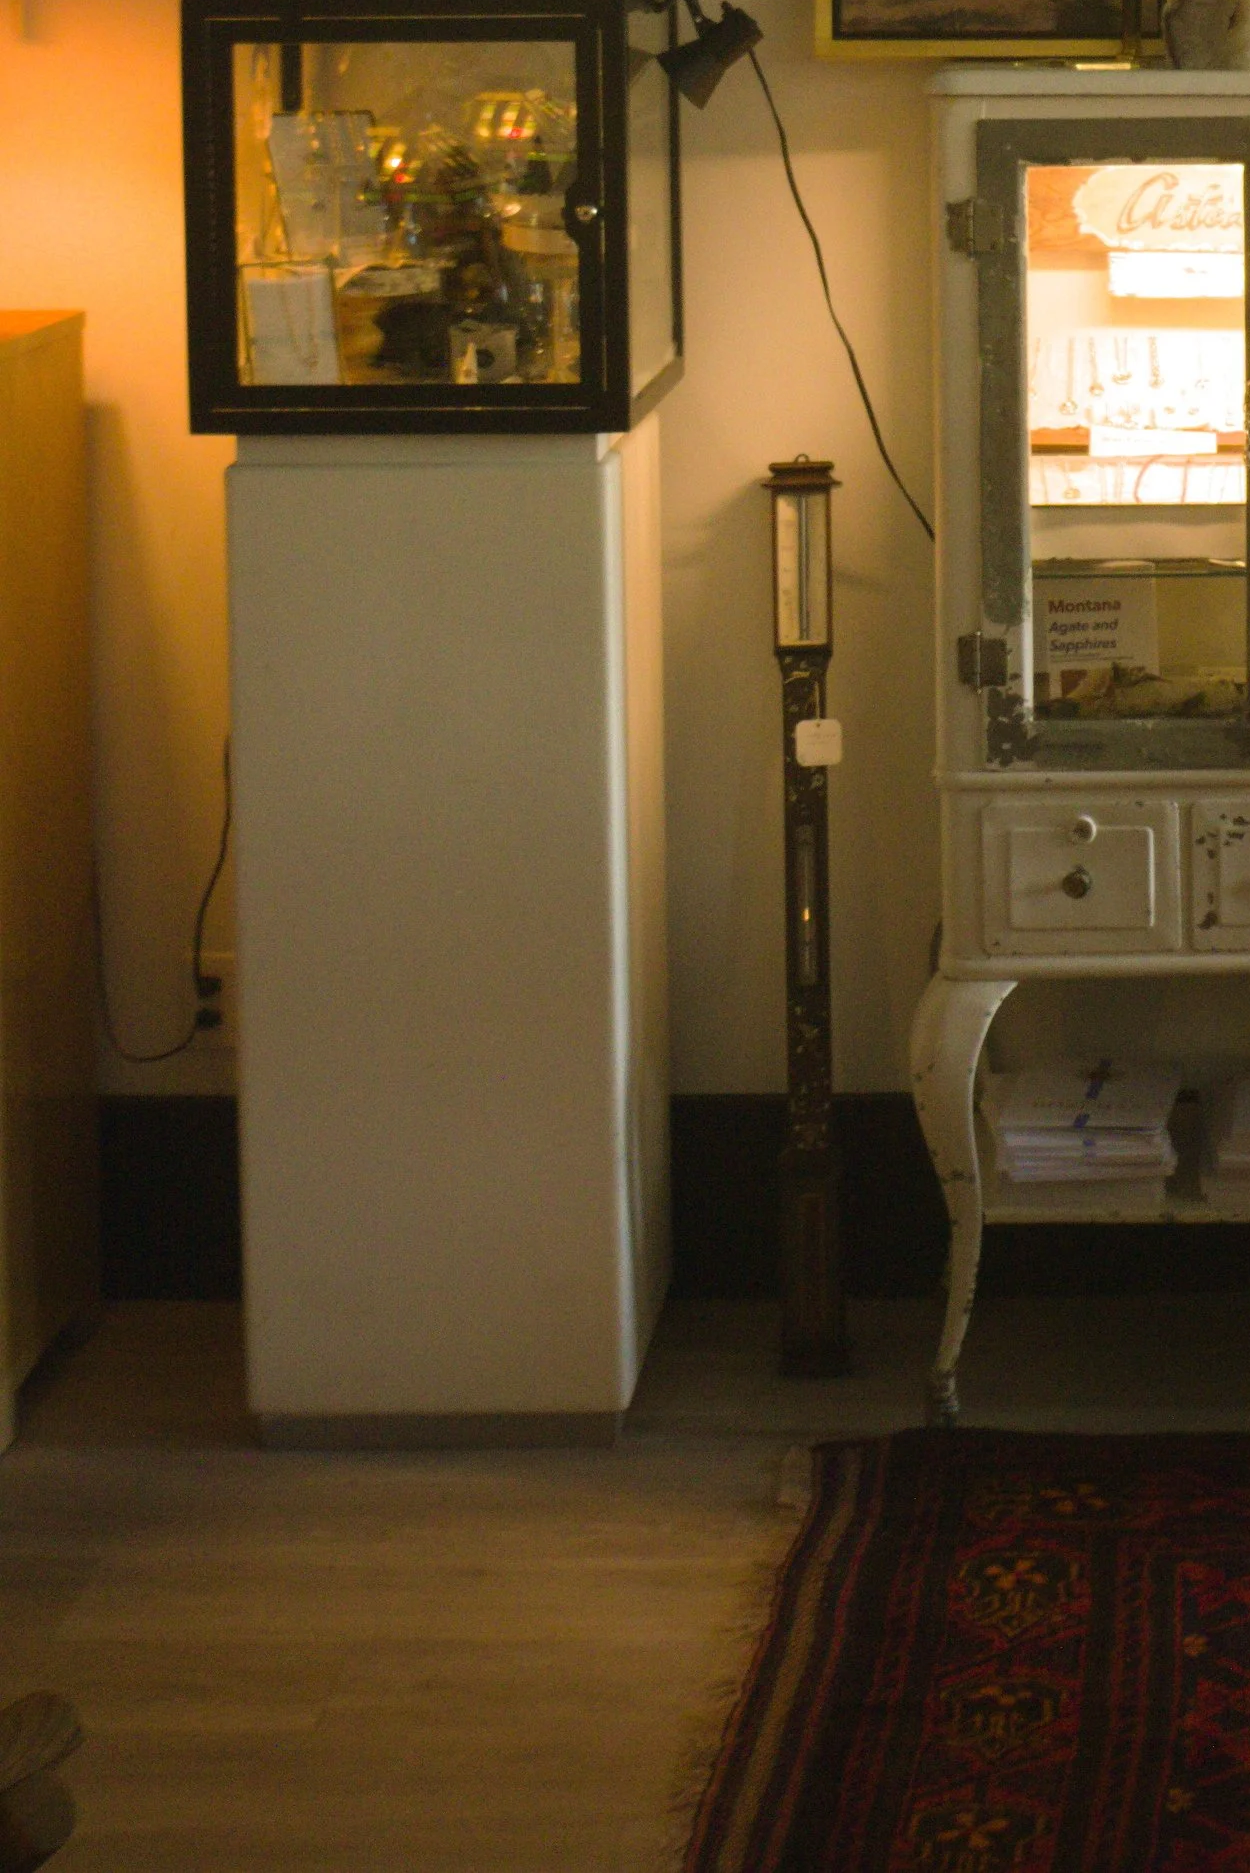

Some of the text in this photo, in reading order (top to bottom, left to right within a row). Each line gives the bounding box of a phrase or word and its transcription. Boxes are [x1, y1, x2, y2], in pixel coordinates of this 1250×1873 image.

[1048, 599, 1121, 614] Montana
[1048, 618, 1119, 636] Agate and
[1049, 638, 1117, 653] Sapphires
